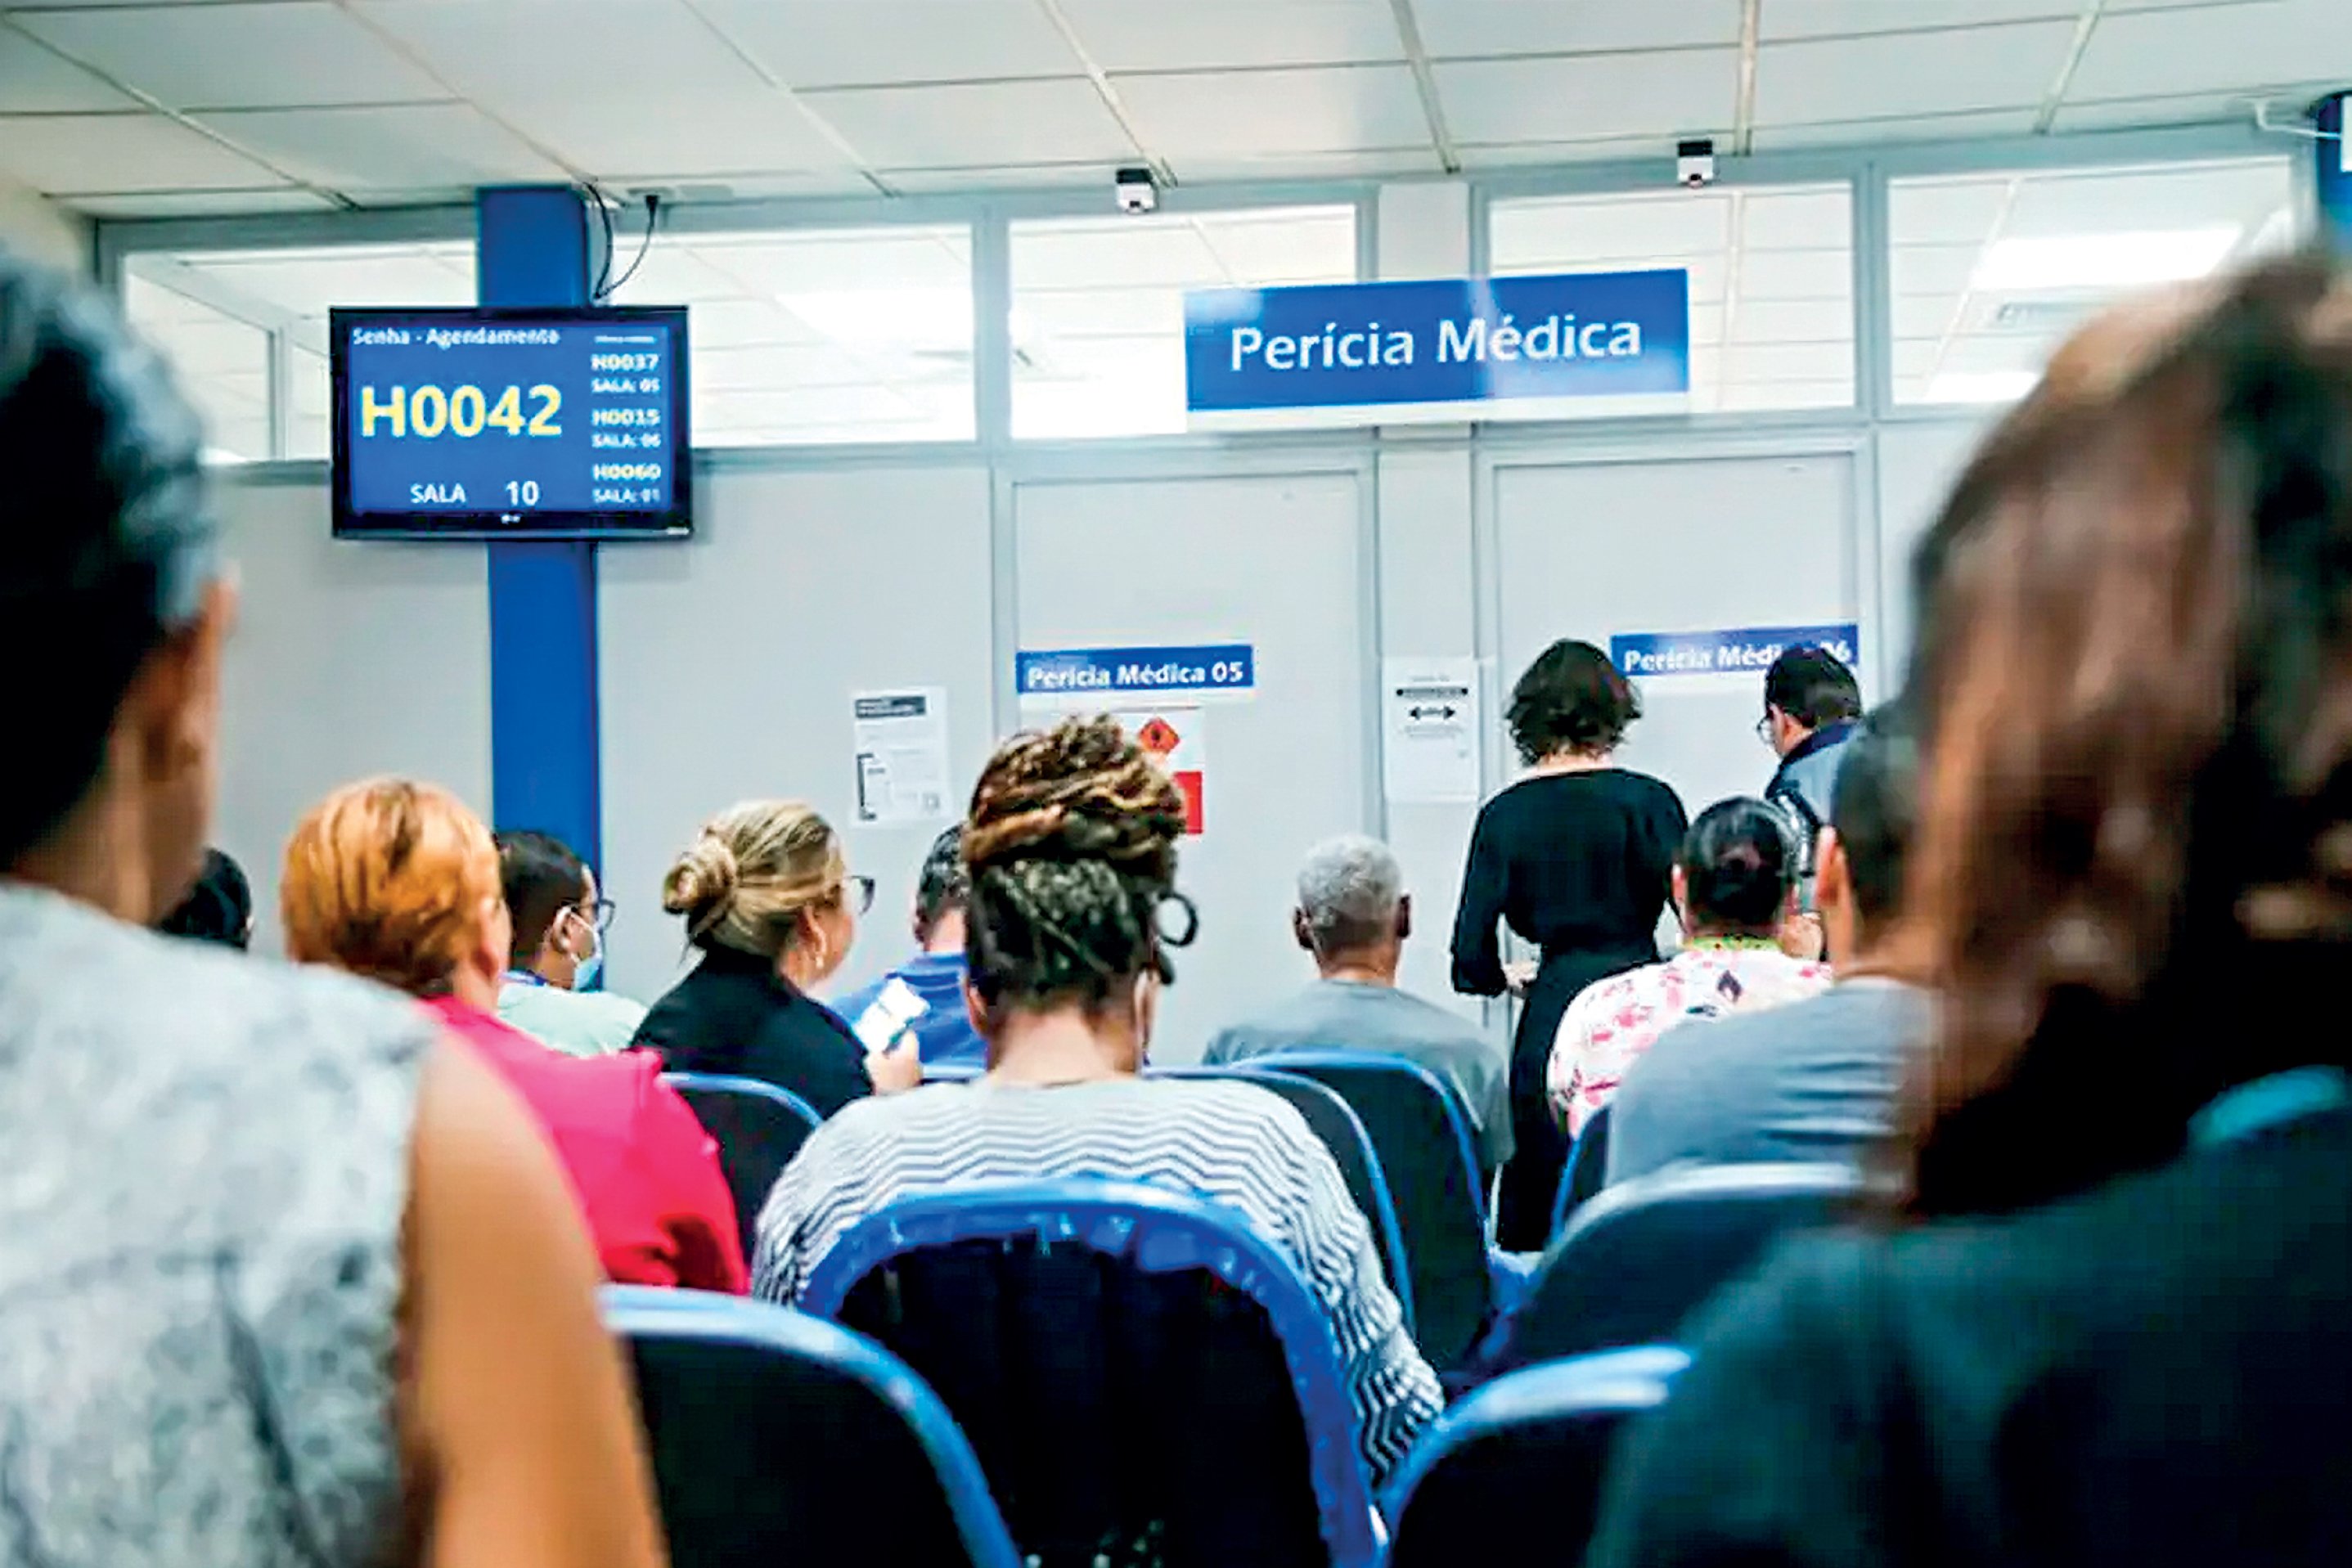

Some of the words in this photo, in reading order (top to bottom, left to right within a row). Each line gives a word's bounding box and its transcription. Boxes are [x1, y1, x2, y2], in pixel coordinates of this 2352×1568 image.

[353, 328, 410, 344] Senha
[425, 327, 560, 350] Agendamento
[1230, 322, 1415, 372] Perícia
[1437, 314, 1641, 363] Médica
[360, 384, 563, 438] H0042
[410, 483, 466, 503] SALA
[506, 481, 540, 505] 10
[1116, 663, 1206, 685] Médica
[1212, 661, 1243, 682] 05
